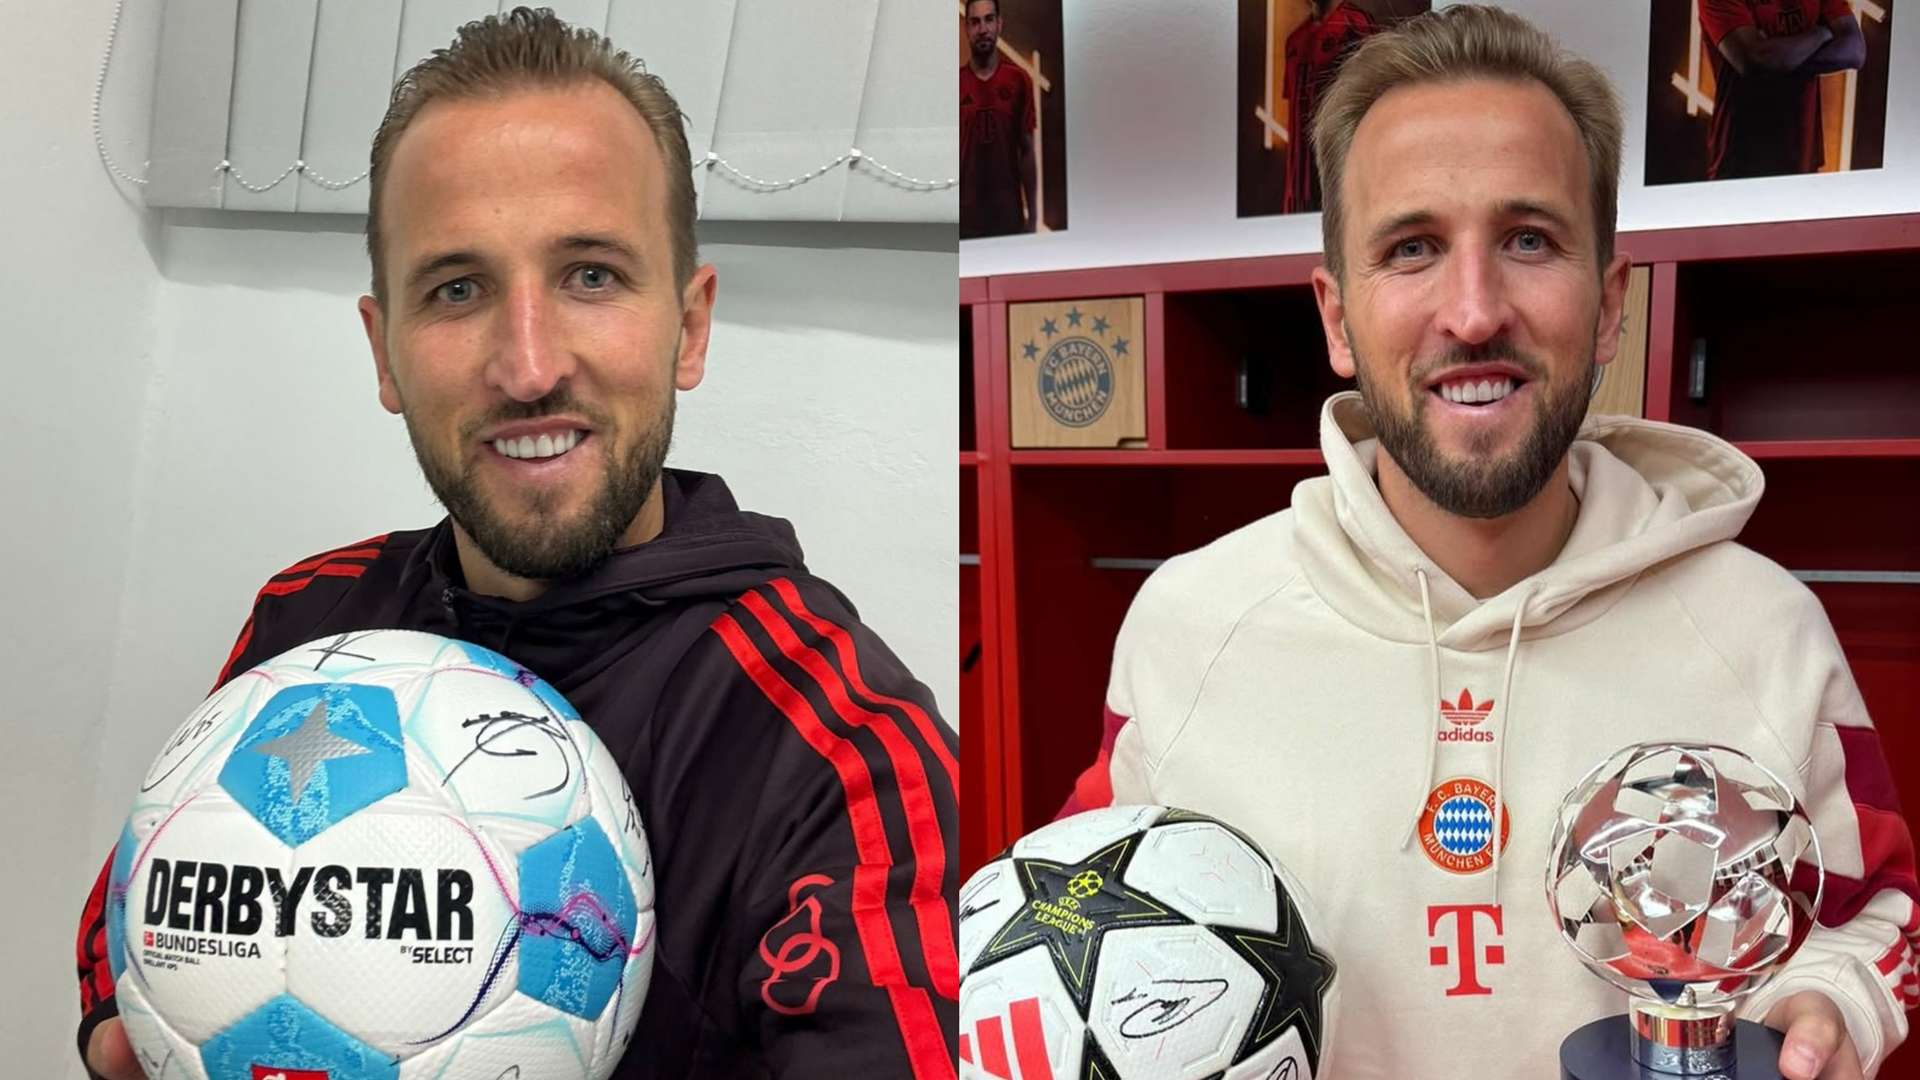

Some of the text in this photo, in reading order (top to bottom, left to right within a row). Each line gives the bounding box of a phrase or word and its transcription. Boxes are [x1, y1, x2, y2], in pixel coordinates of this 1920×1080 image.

[1058, 343, 1107, 375] BAYERN
[1438, 728, 1494, 742] adidas
[1454, 782, 1496, 810] BAYER
[144, 858, 474, 941] DERBYSTAR
[1032, 900, 1095, 929] CHAMPIONS
[1035, 912, 1078, 934] LEAGUE
[156, 932, 261, 959] BUNDESLIGA
[400, 945, 474, 964] BY SELECT
